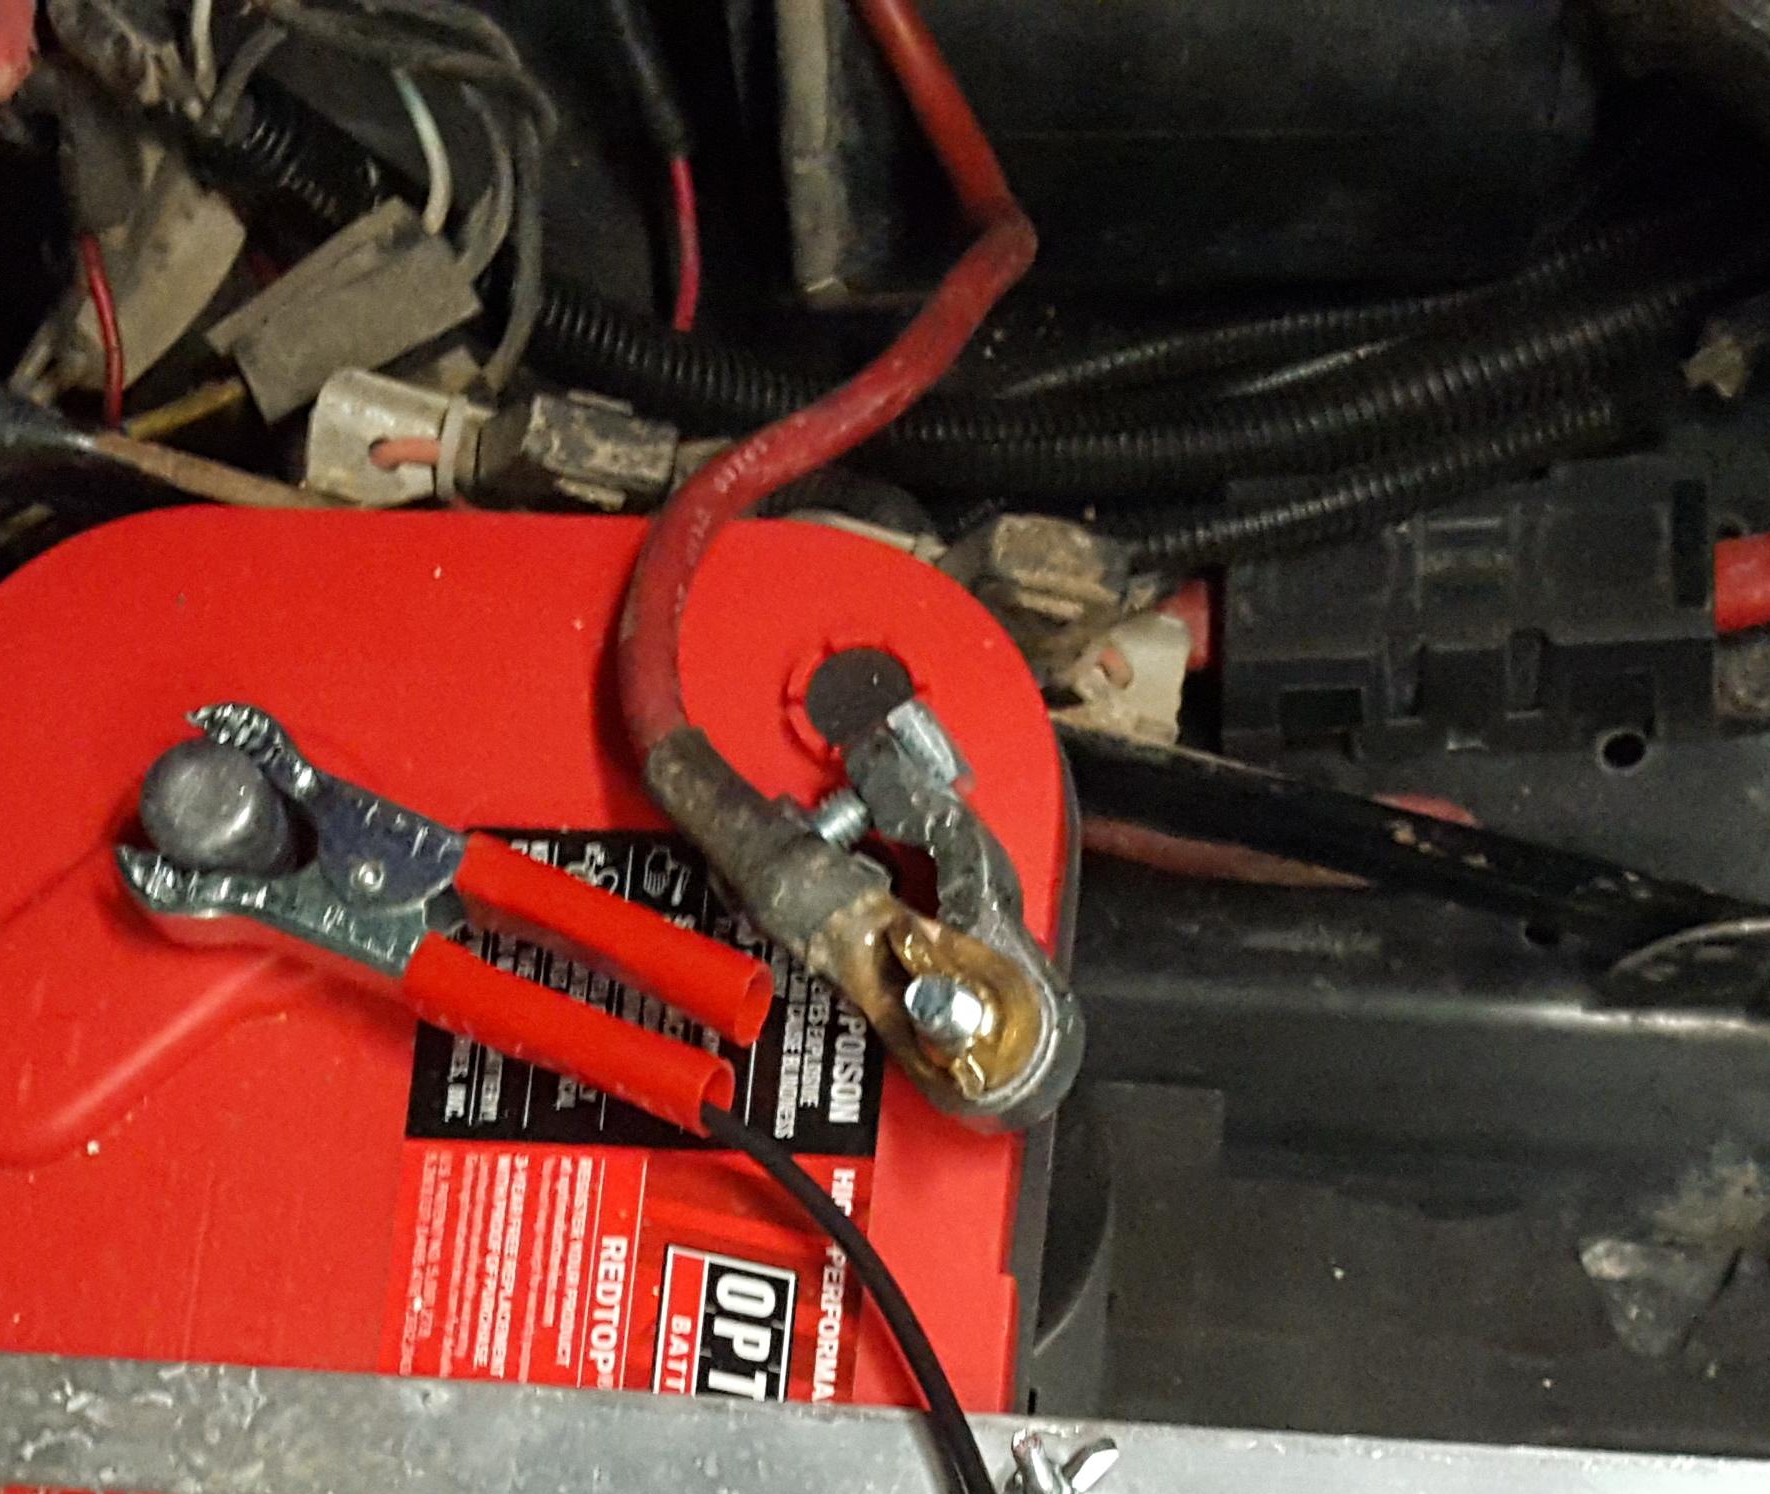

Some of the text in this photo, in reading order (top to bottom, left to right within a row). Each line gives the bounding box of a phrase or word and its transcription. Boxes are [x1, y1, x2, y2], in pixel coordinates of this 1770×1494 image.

[664, 1314, 692, 1395] BATT
[706, 1271, 777, 1402] OPT
[811, 1246, 846, 1401] PERFORMA
